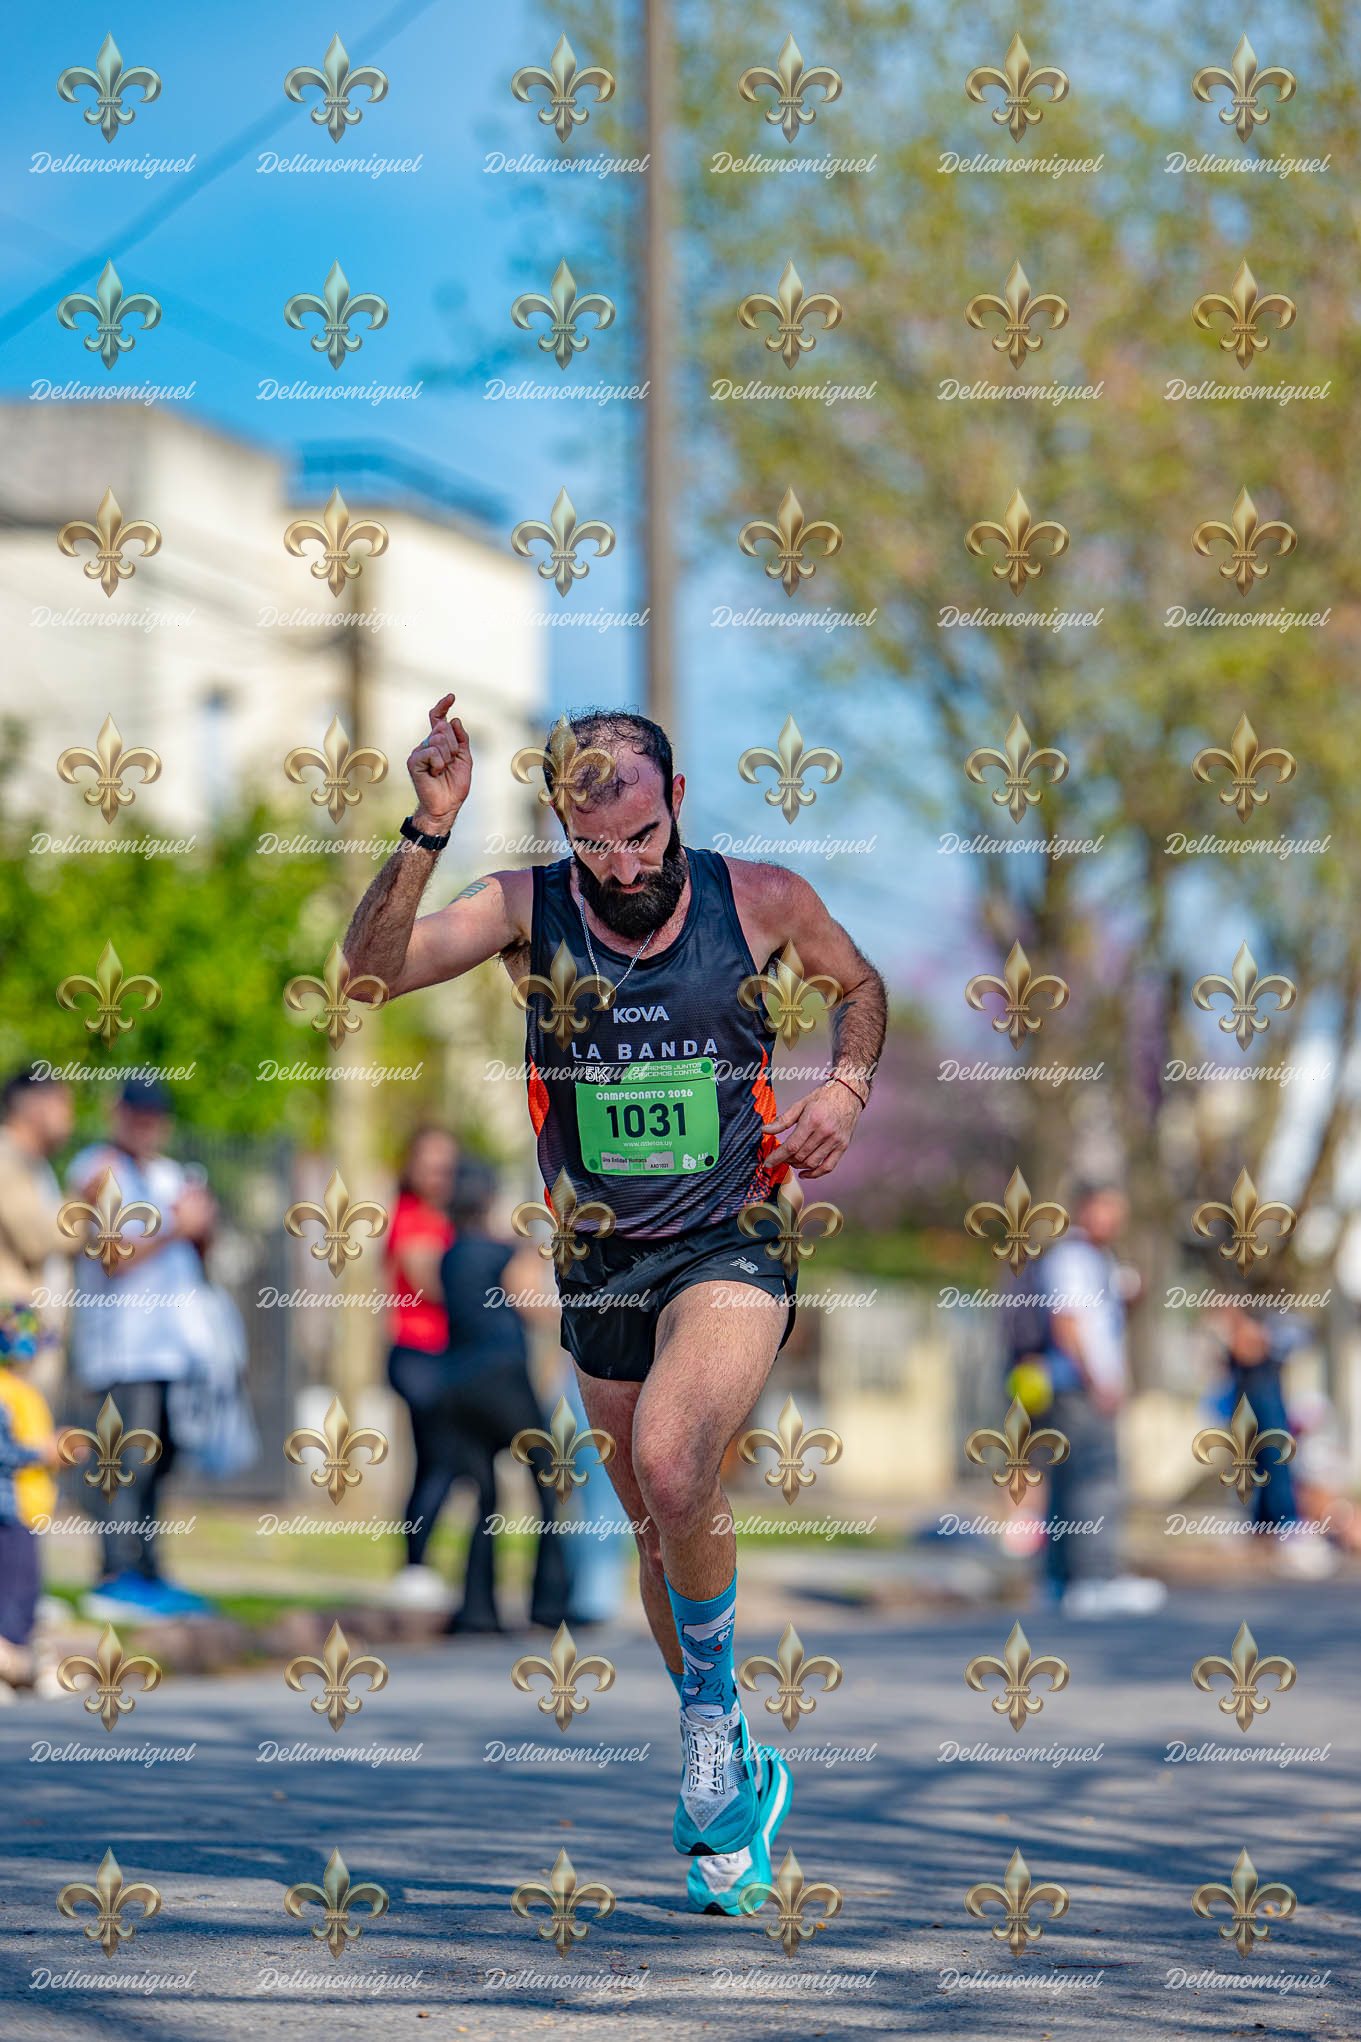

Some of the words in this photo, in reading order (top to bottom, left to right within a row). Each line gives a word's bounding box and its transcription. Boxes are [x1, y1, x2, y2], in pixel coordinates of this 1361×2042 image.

[613, 1005, 670, 1024] KOVA
[571, 1041, 602, 1060] LA
[618, 1038, 718, 1060] BANDA
[585, 1065, 611, 1082] 5K
[595, 1090, 665, 1100] CAMPEONATO
[668, 1088, 694, 1098] 2026
[606, 1102, 687, 1138] 1031
